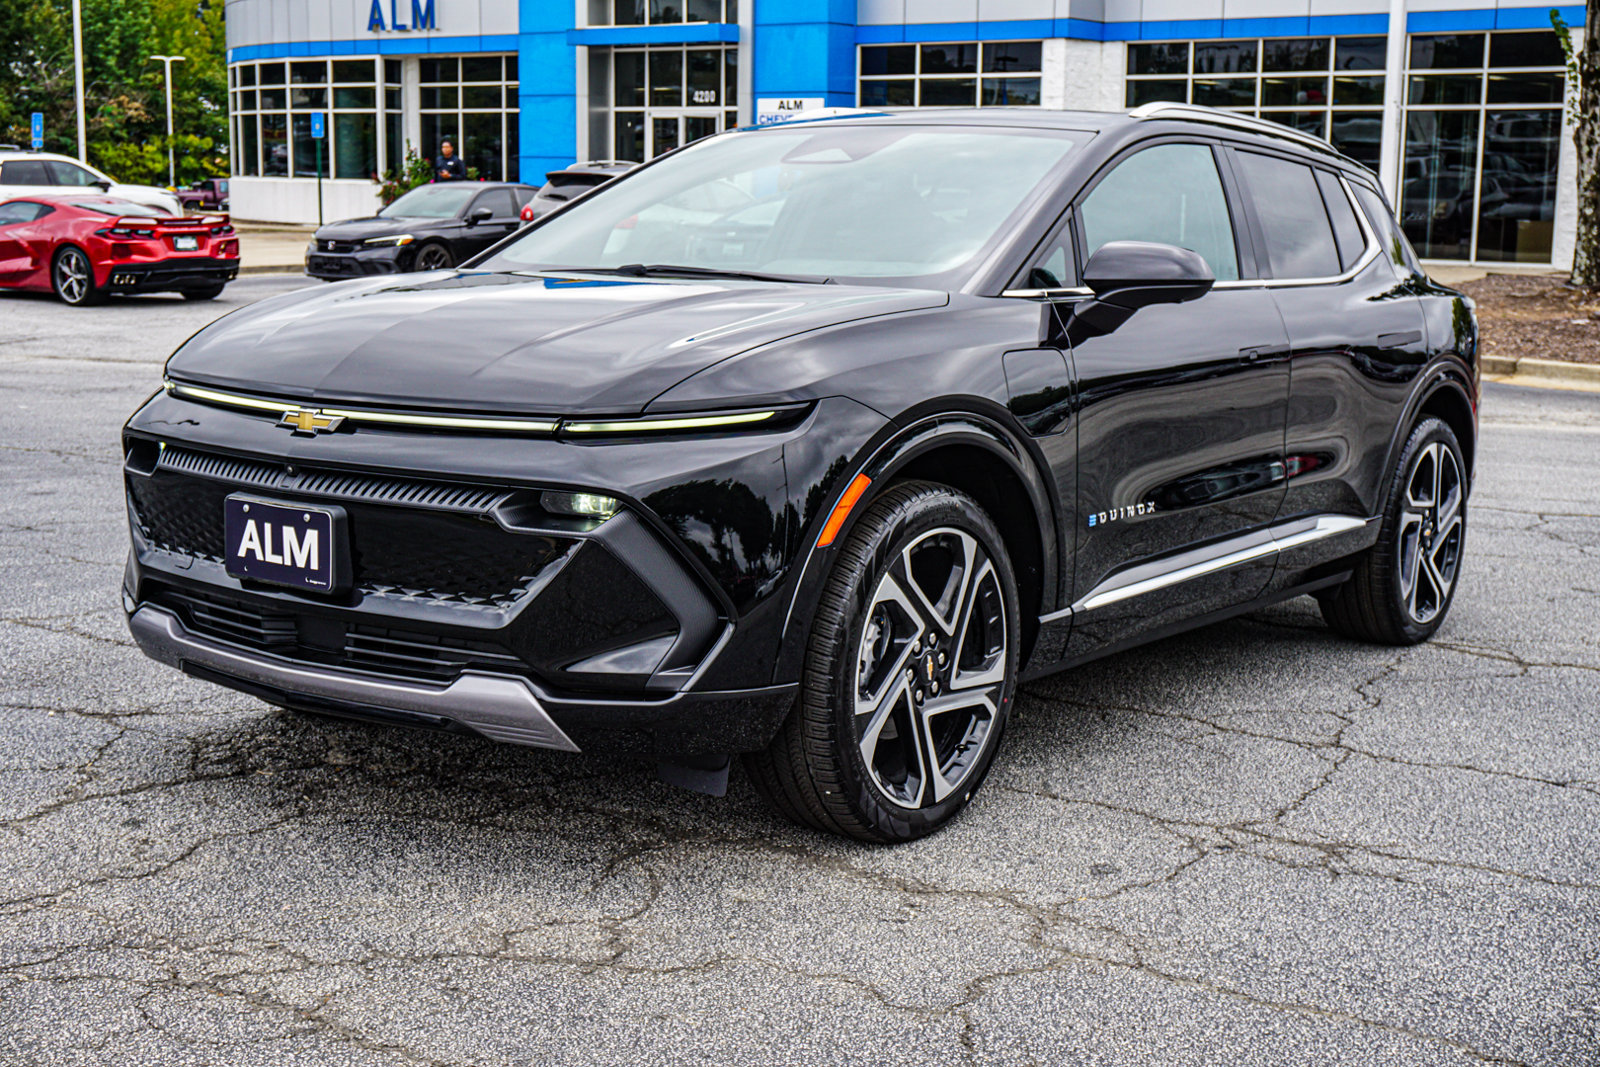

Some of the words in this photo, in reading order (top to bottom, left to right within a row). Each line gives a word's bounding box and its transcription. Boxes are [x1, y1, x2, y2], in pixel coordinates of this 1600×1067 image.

[367, 0, 436, 31] ALM
[692, 90, 716, 103] 4200
[778, 100, 803, 110] ALM
[759, 114, 794, 125] CHEV
[1088, 501, 1155, 527] EQUINOX
[237, 519, 319, 571] ALM
